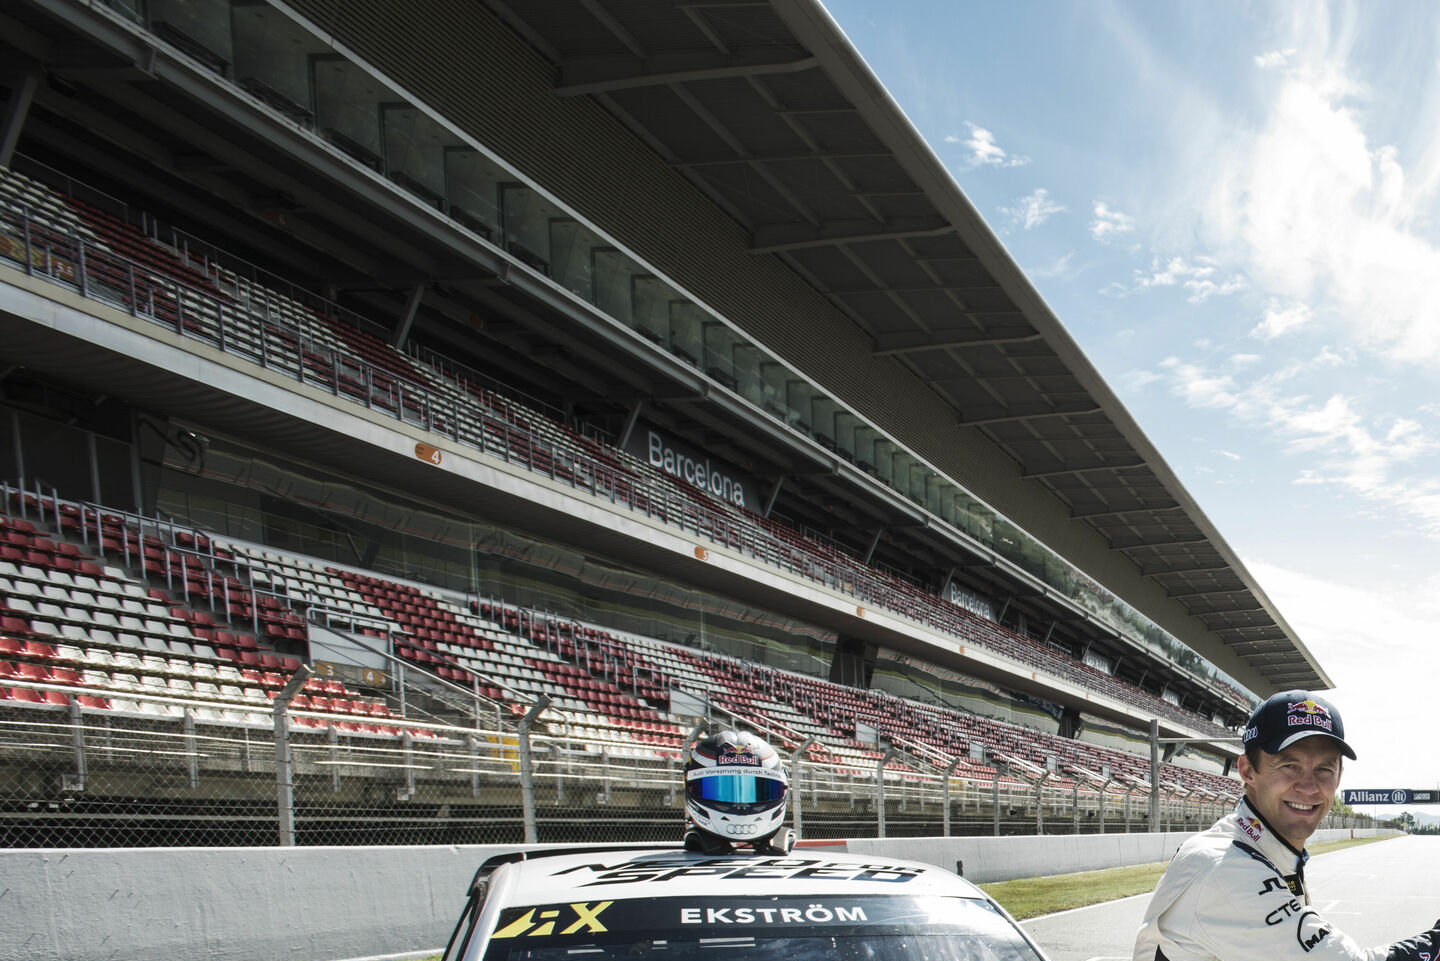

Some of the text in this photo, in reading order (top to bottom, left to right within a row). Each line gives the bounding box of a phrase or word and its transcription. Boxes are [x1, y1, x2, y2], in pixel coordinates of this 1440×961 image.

[431, 451, 440, 464] 4
[649, 431, 746, 507] Barcelona
[1287, 714, 1333, 731] Red Bull
[719, 754, 759, 765] Red Bull
[1349, 791, 1389, 802] Allianz
[1236, 818, 1261, 842] Red Bull
[573, 865, 922, 888] SPEED
[680, 903, 869, 924] EKSTRÖM
[1265, 898, 1302, 927] CTE
